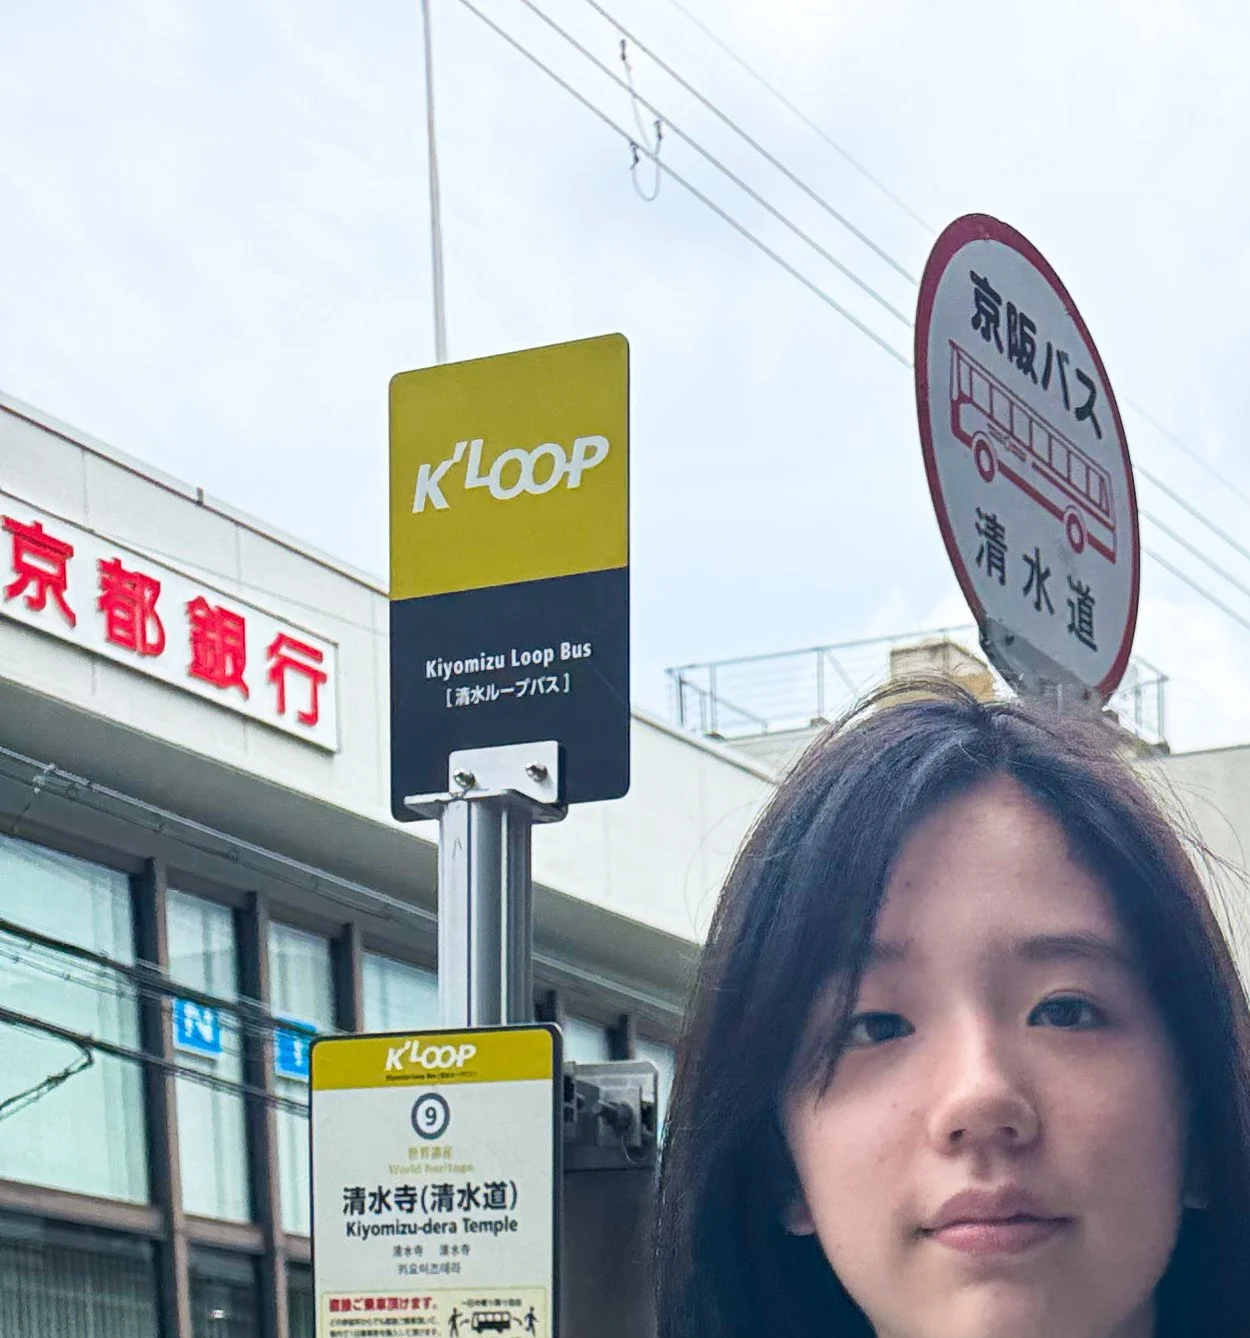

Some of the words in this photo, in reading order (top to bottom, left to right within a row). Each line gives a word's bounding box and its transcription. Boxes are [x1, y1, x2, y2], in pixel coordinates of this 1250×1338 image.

[968, 269, 1104, 440] 京阪バス
[411, 434, 611, 515] K'LOOP
[974, 506, 1099, 653] 清水道
[1, 514, 328, 728] 京都銀行
[425, 651, 505, 682] Kiyomizu
[511, 646, 554, 669] Loop
[559, 641, 592, 661] Bus
[384, 1040, 477, 1071] K'LOOP
[424, 1106, 438, 1127] 9
[342, 1180, 518, 1216] 清水寺(清水道)
[345, 1218, 457, 1241] Kiyomizu-dera
[462, 1215, 518, 1237] Temple
